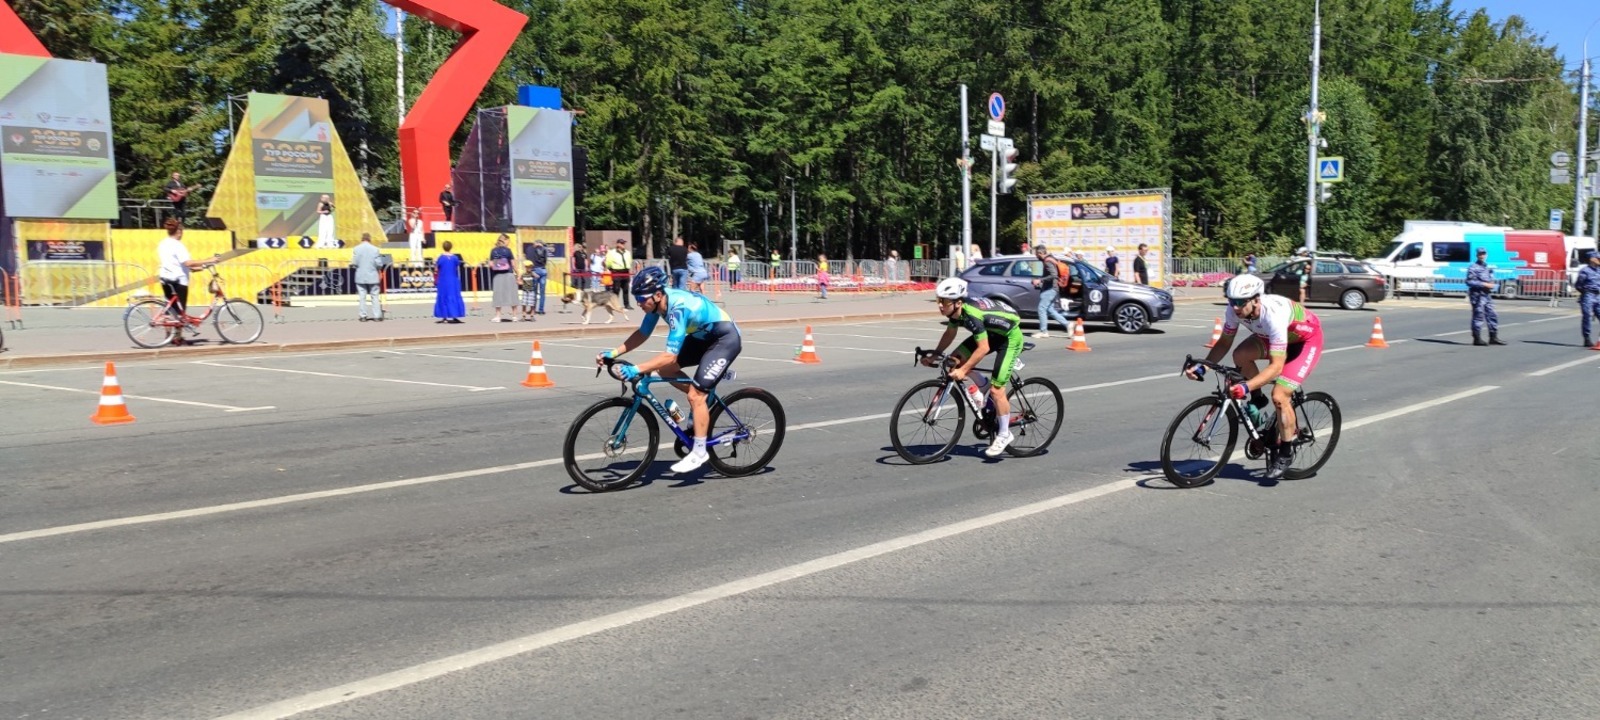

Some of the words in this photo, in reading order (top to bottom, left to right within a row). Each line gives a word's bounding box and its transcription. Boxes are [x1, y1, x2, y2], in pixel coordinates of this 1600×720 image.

[30, 128, 82, 147] 2025
[261, 142, 324, 165] 2025
[270, 239, 280, 248] 2
[302, 238, 311, 248] 1
[399, 270, 435, 288] 202
[703, 357, 728, 381] VINO
[1297, 346, 1317, 379] BELARUS
